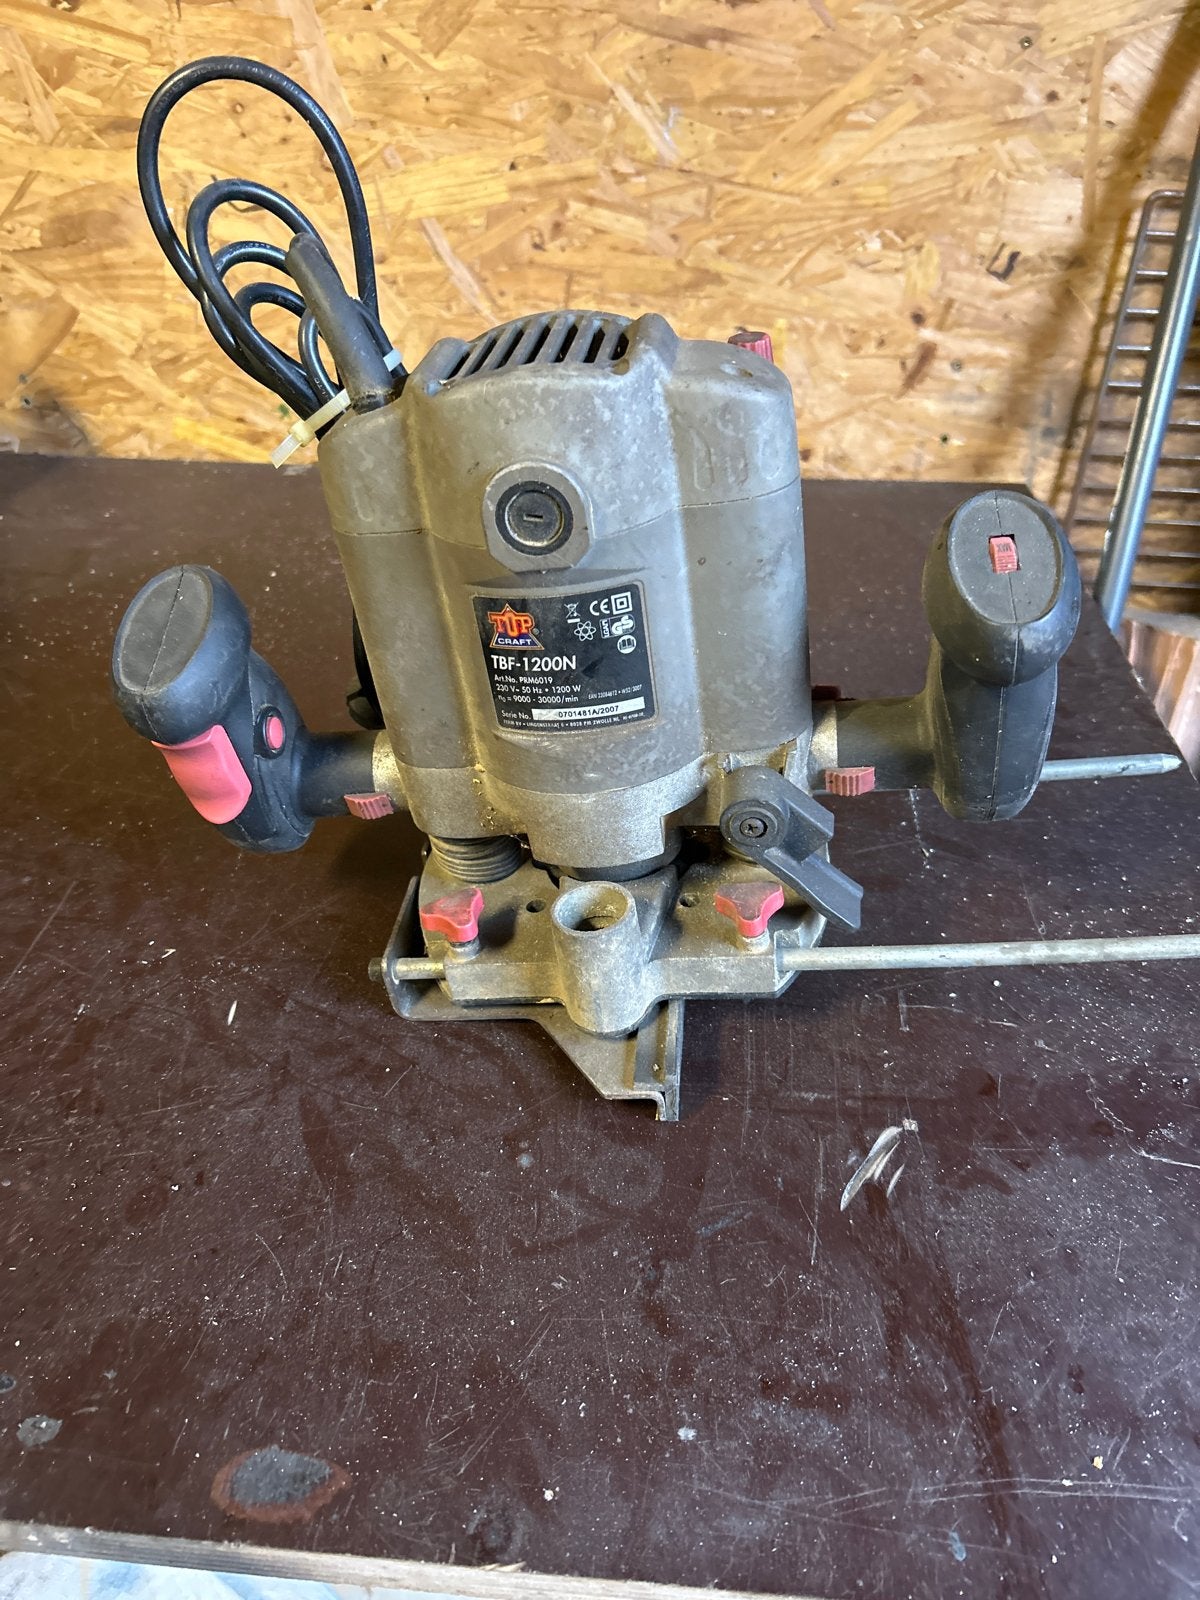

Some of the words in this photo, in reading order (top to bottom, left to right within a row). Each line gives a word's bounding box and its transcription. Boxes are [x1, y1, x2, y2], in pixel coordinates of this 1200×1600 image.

[490, 611, 533, 638] TOP
[497, 637, 532, 646] CRAFT
[490, 654, 577, 672] TBF-1200N
[519, 676, 553, 684] PRM6019
[495, 684, 509, 692] 230
[521, 686, 531, 694] 50
[552, 685, 571, 693] 1200
[572, 684, 581, 692] W
[513, 695, 531, 703] 9000
[537, 695, 579, 704] 30000/min
[501, 709, 518, 718] Serie
[518, 712, 532, 720] No.
